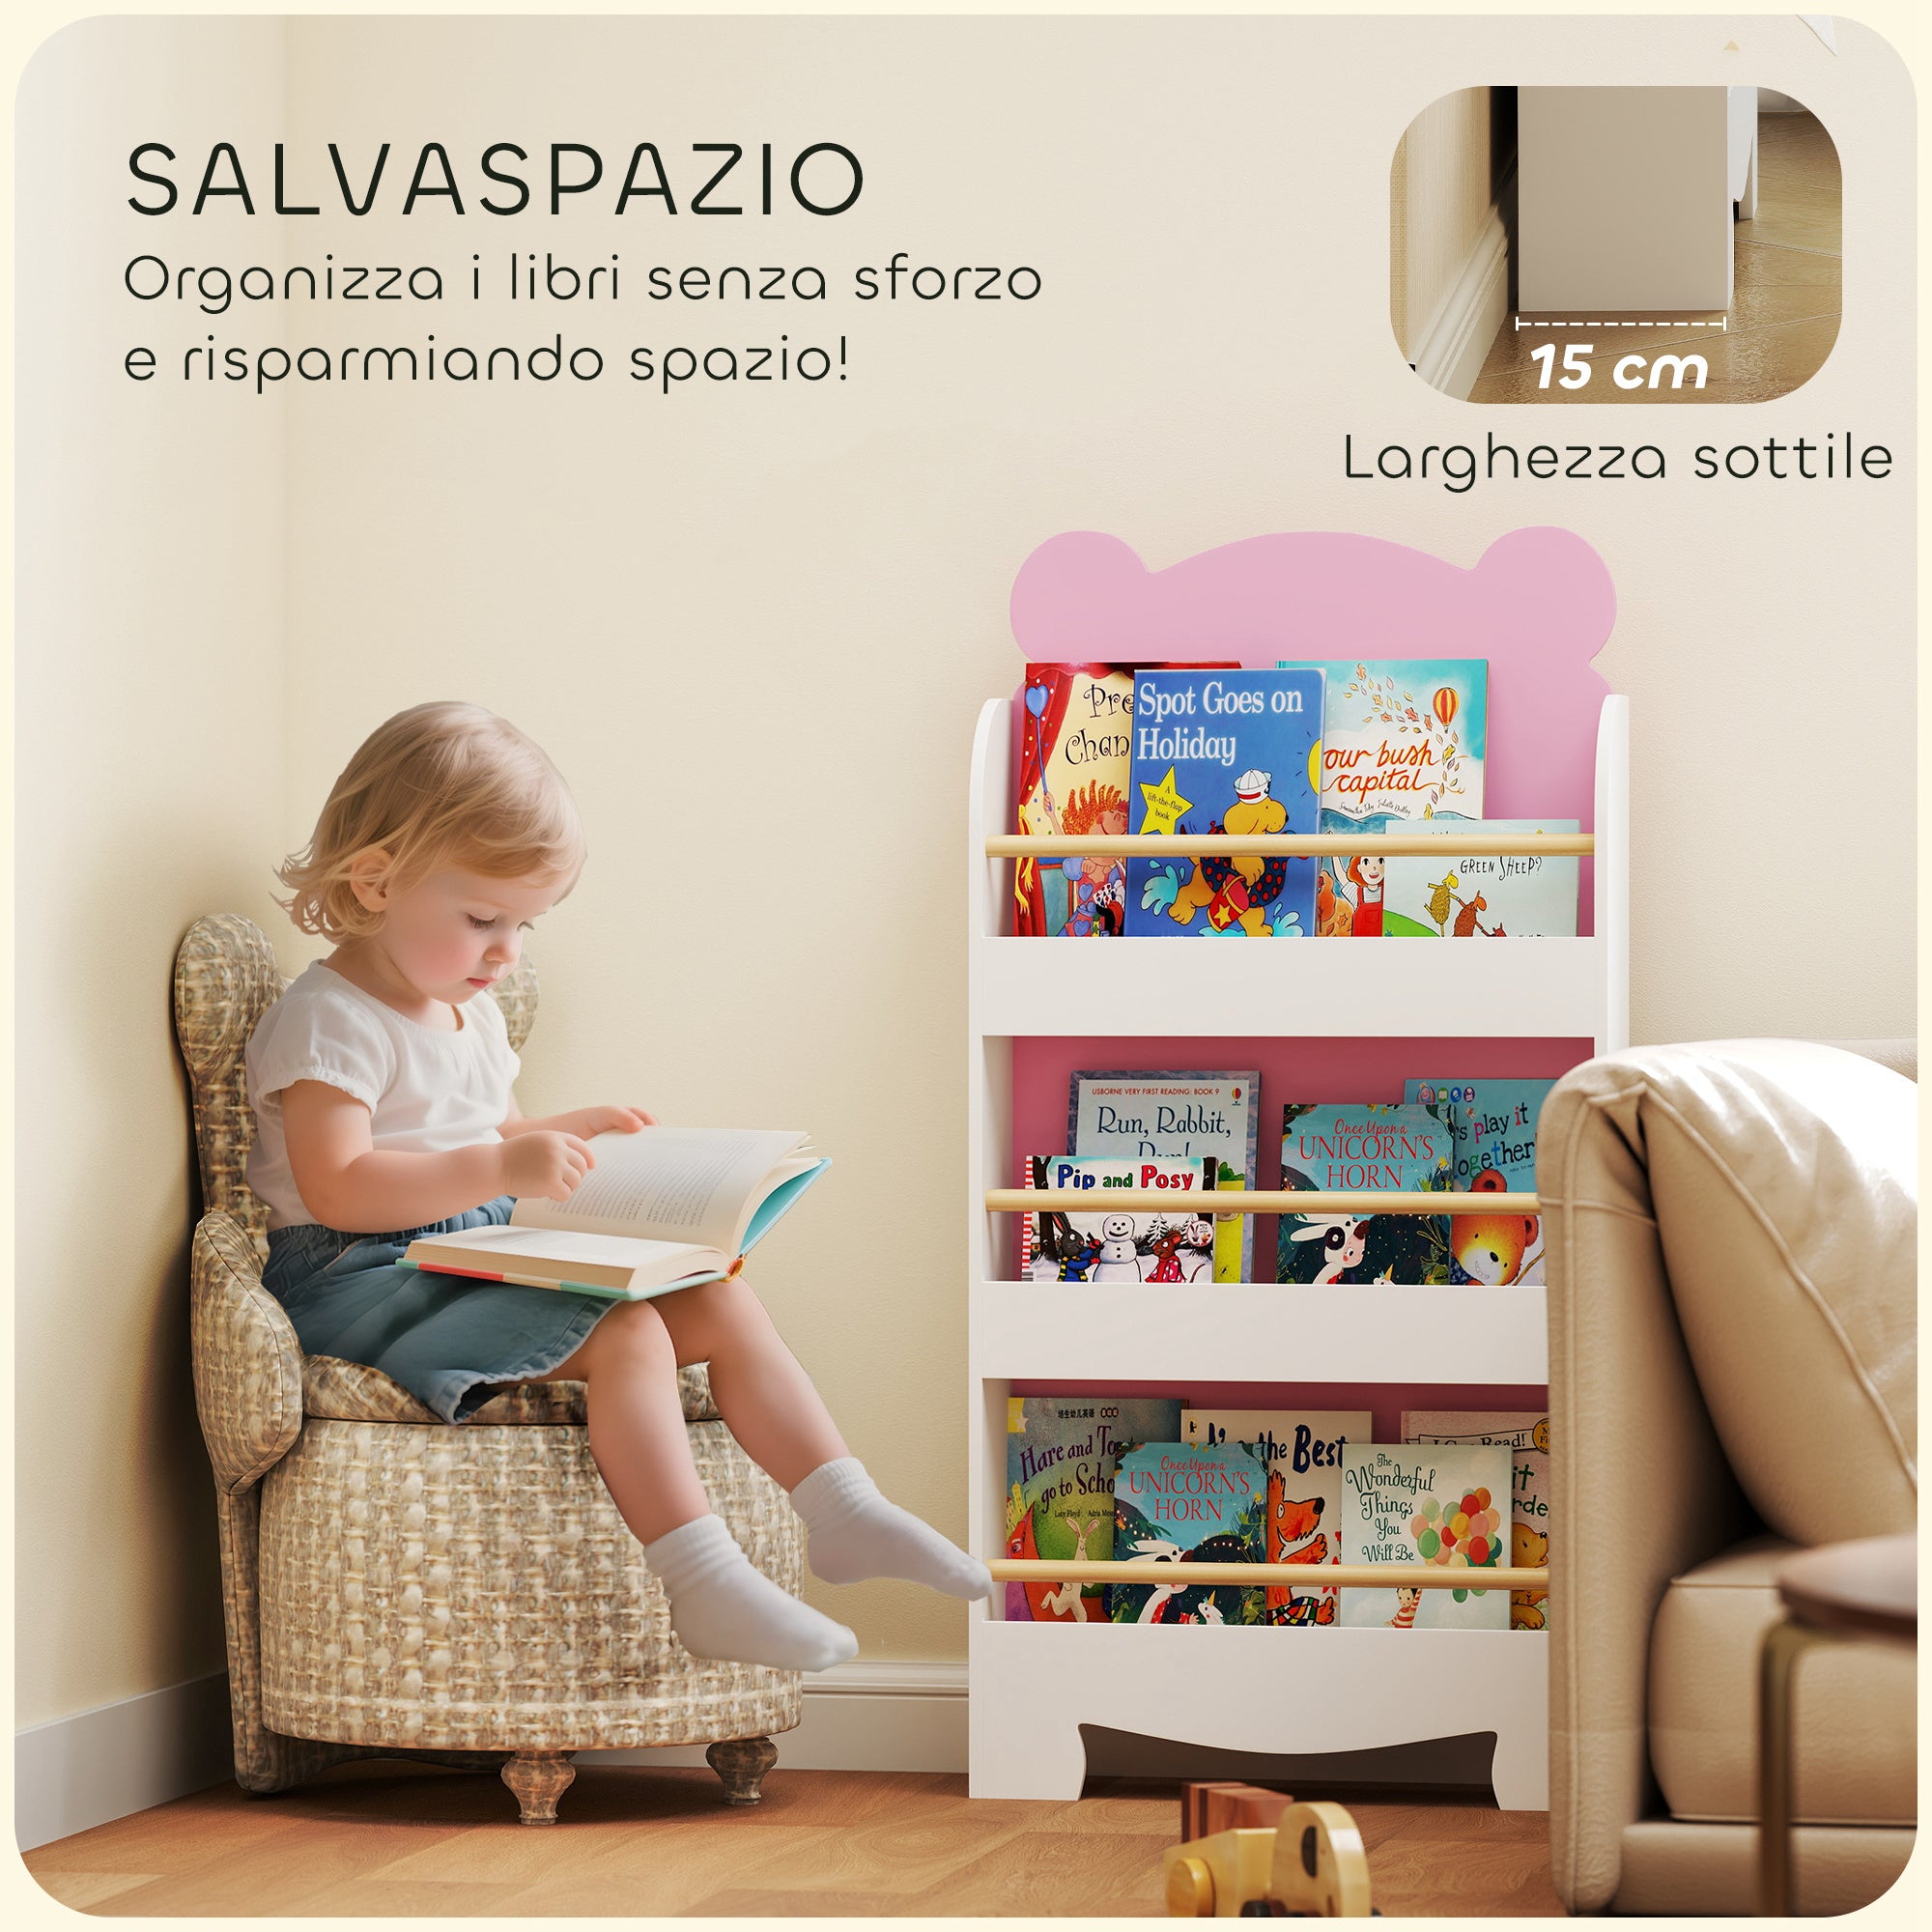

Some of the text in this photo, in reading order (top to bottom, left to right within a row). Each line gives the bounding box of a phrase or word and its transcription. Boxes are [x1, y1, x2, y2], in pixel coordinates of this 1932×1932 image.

[1083, 684, 1134, 718] Pre
[1138, 681, 1303, 723] Spot Goes on
[1136, 726, 1236, 766] Holiday
[1323, 739, 1441, 769] our bush
[1165, 785, 1171, 794] A
[1333, 768, 1432, 804] capital
[1147, 791, 1183, 813] lift-the-flap
[1154, 808, 1170, 820] book
[1460, 856, 1543, 881] GREEN SHEEP?
[1097, 1103, 1231, 1138] Run, Rabbit,
[1335, 1118, 1408, 1143] Once Upon a
[1473, 1113, 1510, 1144] play
[1514, 1102, 1528, 1126] it
[1299, 1133, 1434, 1159] UNICORN'S
[1454, 1140, 1535, 1179] ogether
[1058, 1164, 1194, 1190] Pip and Posy
[1326, 1164, 1404, 1188] HORN
[1020, 1445, 1065, 1485] Hare
[1067, 1435, 1093, 1460] and
[1293, 1424, 1348, 1474] Best
[1377, 1453, 1392, 1467] The
[1160, 1455, 1186, 1470] Once
[1189, 1458, 1219, 1478] Upon
[1345, 1463, 1436, 1495] Wonderful
[1129, 1470, 1251, 1495] UNICORN'S
[1041, 1487, 1057, 1515] go
[1059, 1477, 1073, 1496] to
[1154, 1498, 1223, 1520] HORN
[1359, 1491, 1413, 1520] Things
[1374, 1517, 1401, 1541] You
[1362, 1544, 1414, 1563] Will Be
